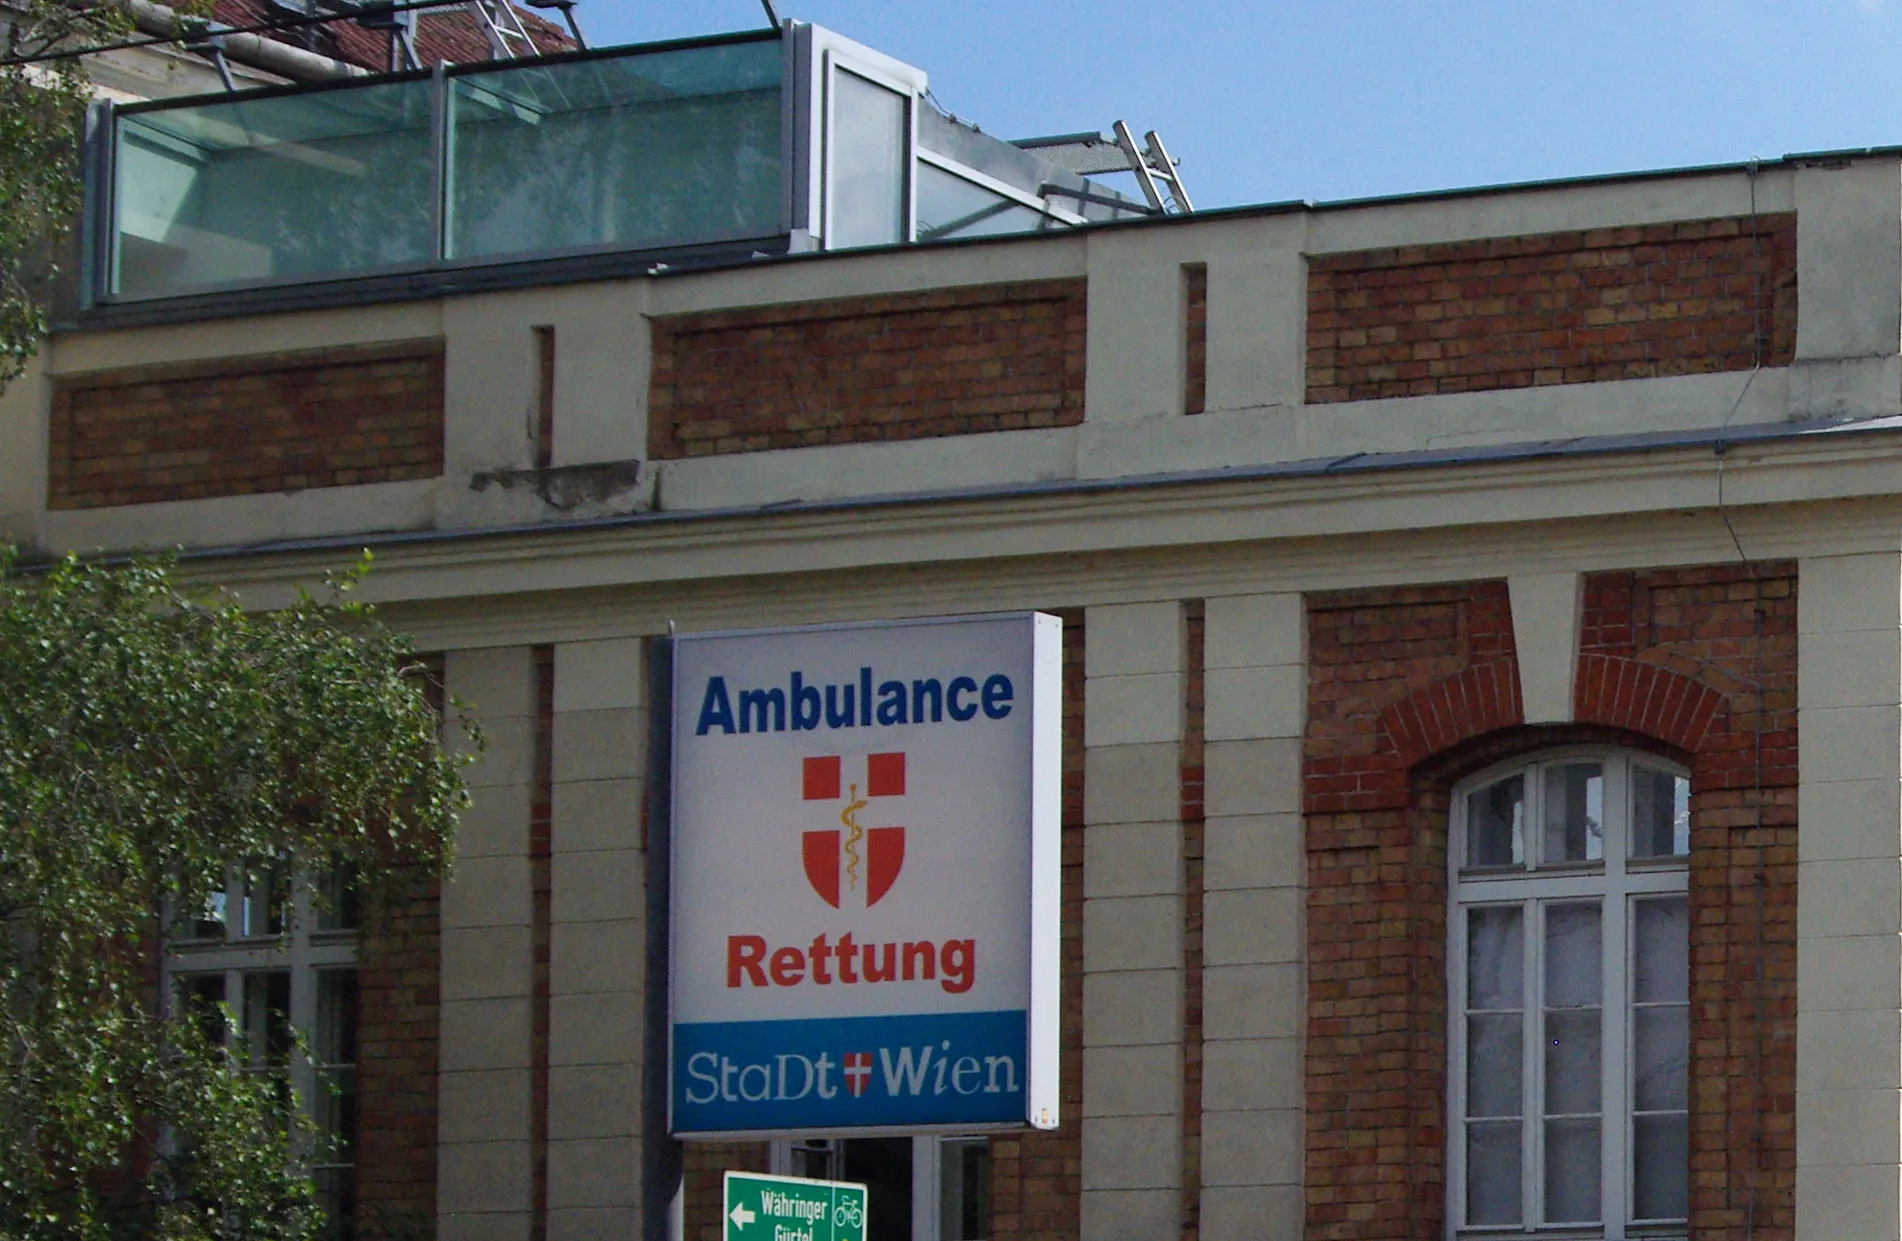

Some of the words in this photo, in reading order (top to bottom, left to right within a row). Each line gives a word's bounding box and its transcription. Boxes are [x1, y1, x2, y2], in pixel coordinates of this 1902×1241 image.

[695, 667, 1014, 736] Ambulance
[726, 931, 976, 994] Rettung
[686, 1051, 838, 1104] StaDt
[878, 1039, 1019, 1097] Wien
[760, 1189, 828, 1226] Währinger
